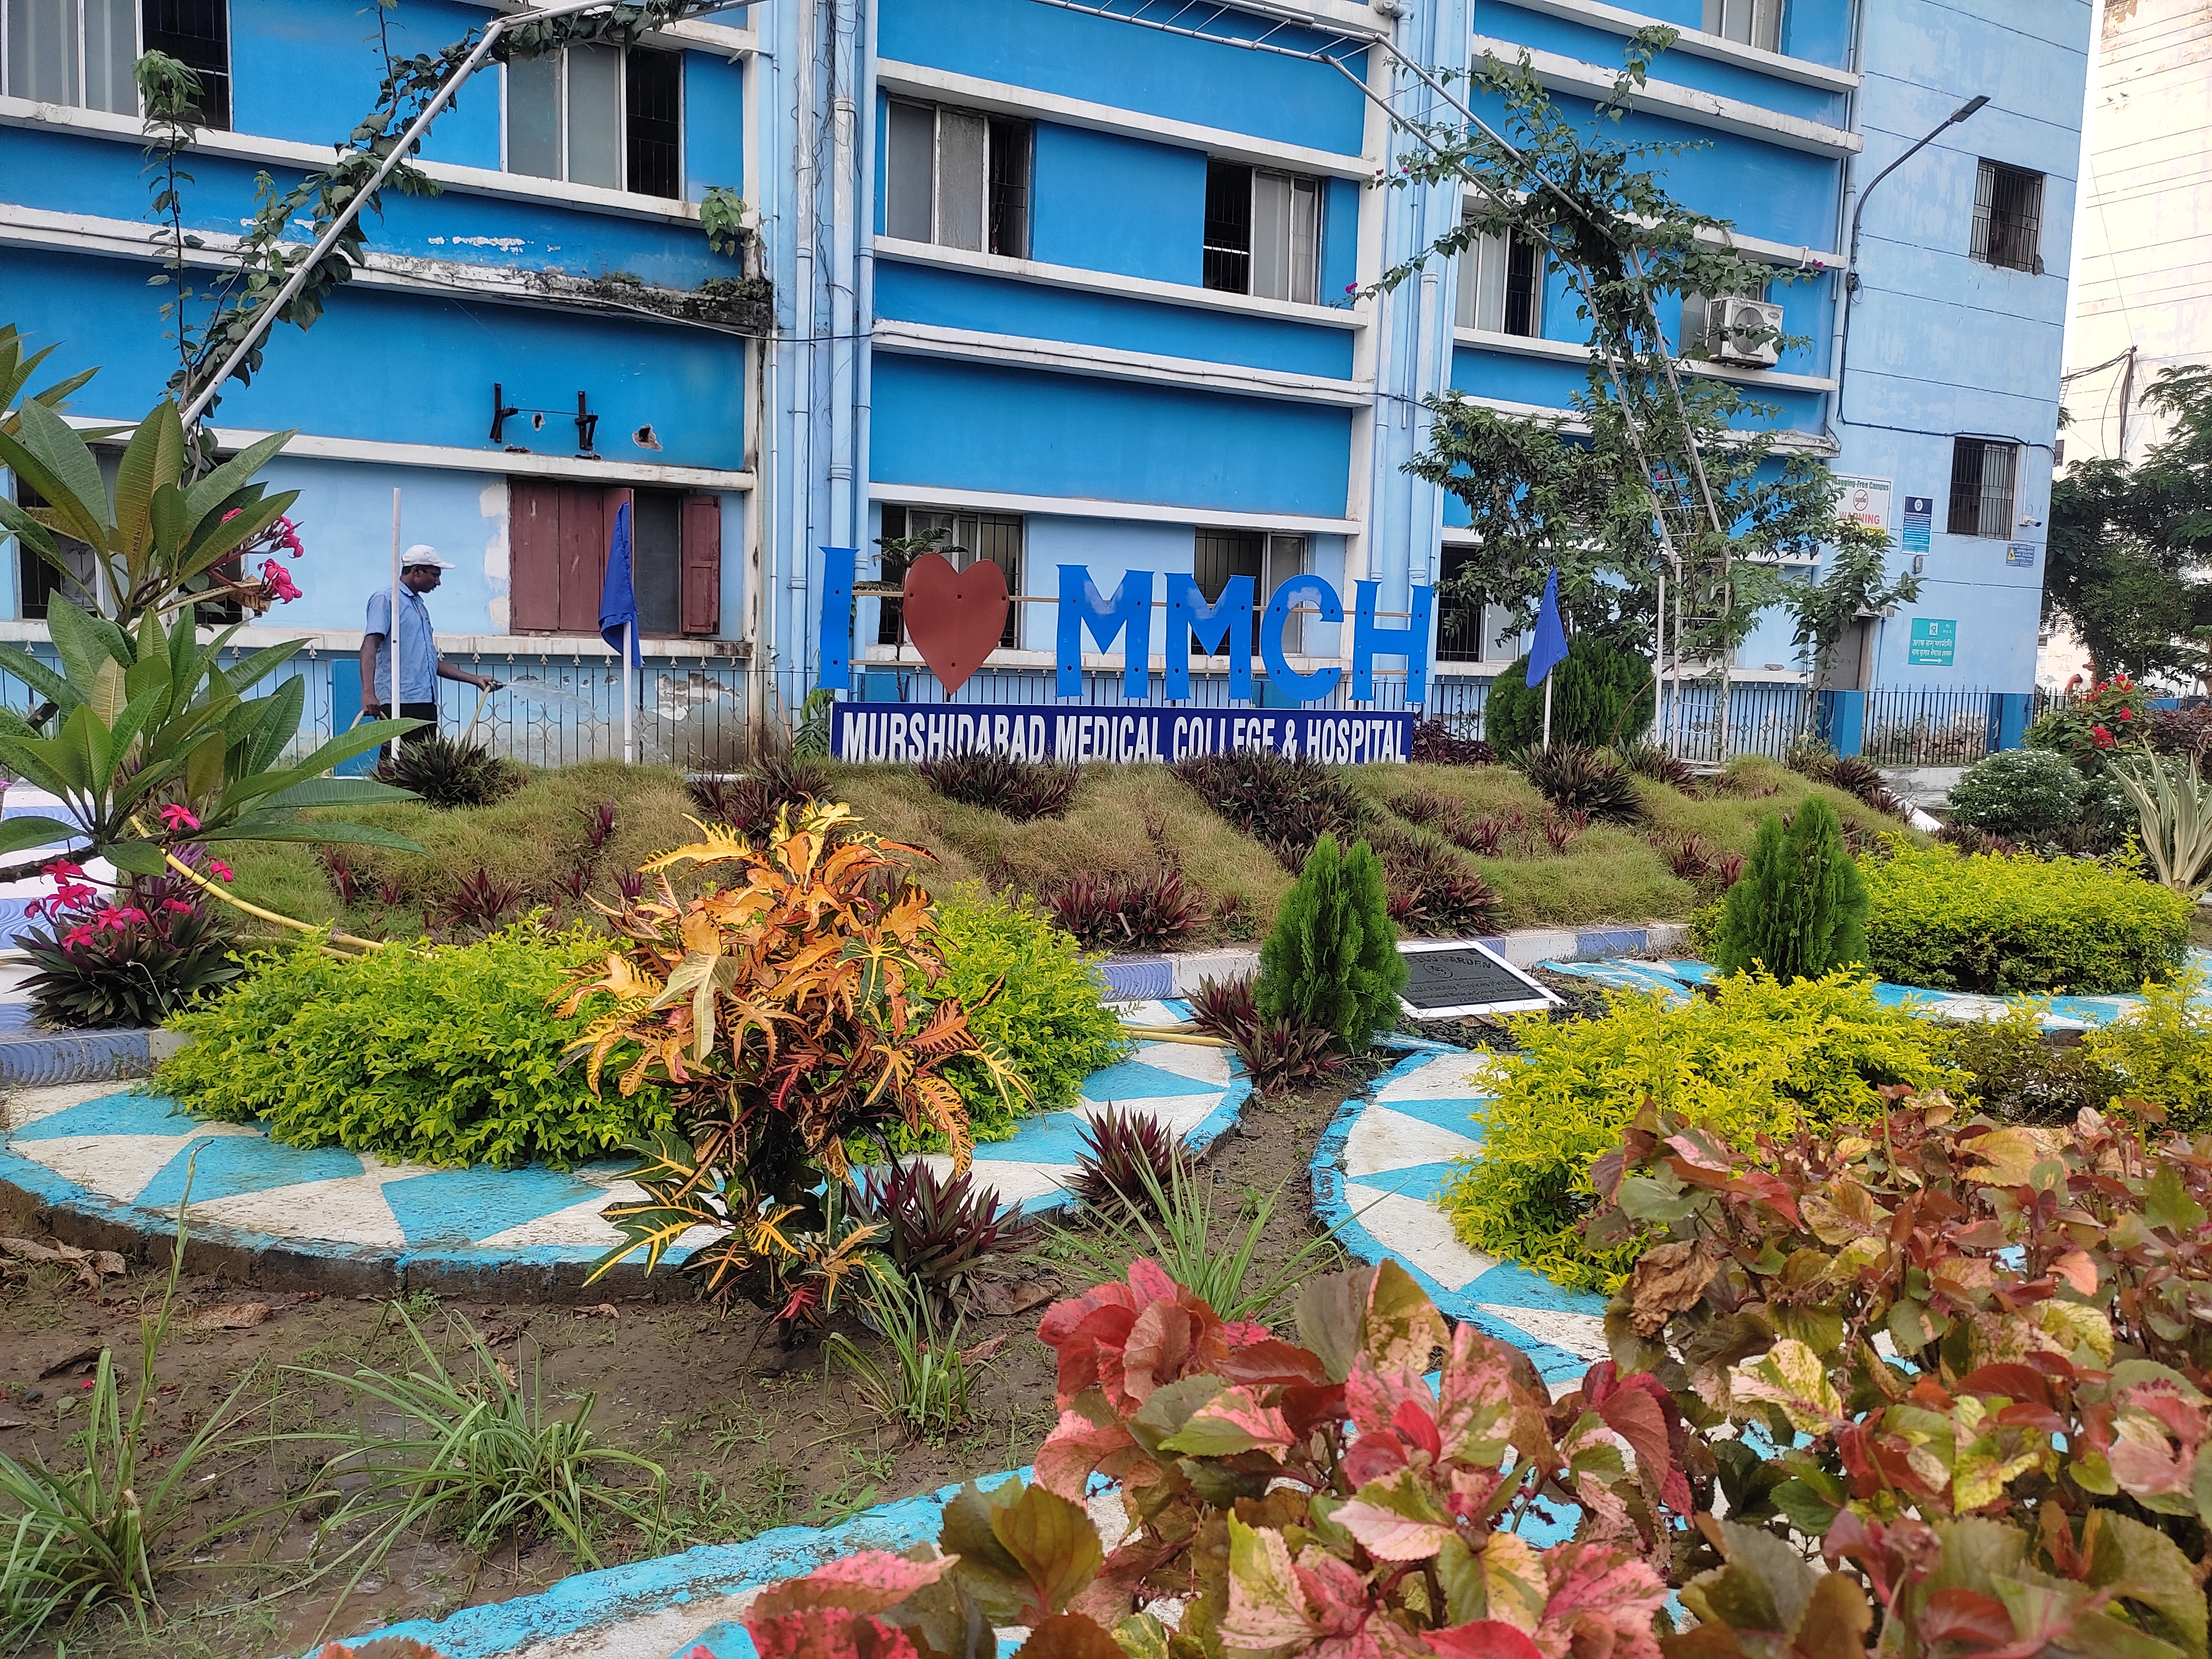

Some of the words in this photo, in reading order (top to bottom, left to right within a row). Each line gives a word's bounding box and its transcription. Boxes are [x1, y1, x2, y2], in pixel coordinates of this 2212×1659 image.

[1837, 479, 1868, 489] agging-Free
[1869, 482, 1889, 491] Campus
[817, 546, 860, 690] I
[1055, 564, 1434, 703] MMCH
[842, 712, 1046, 764] MURSHIDABAD
[1055, 715, 1164, 764] MEDICAL
[1173, 717, 1275, 765] COLLEGE
[1282, 719, 1297, 764] &
[1306, 718, 1406, 765] HOSPITAL
[1439, 956, 1491, 968] GARDEN
